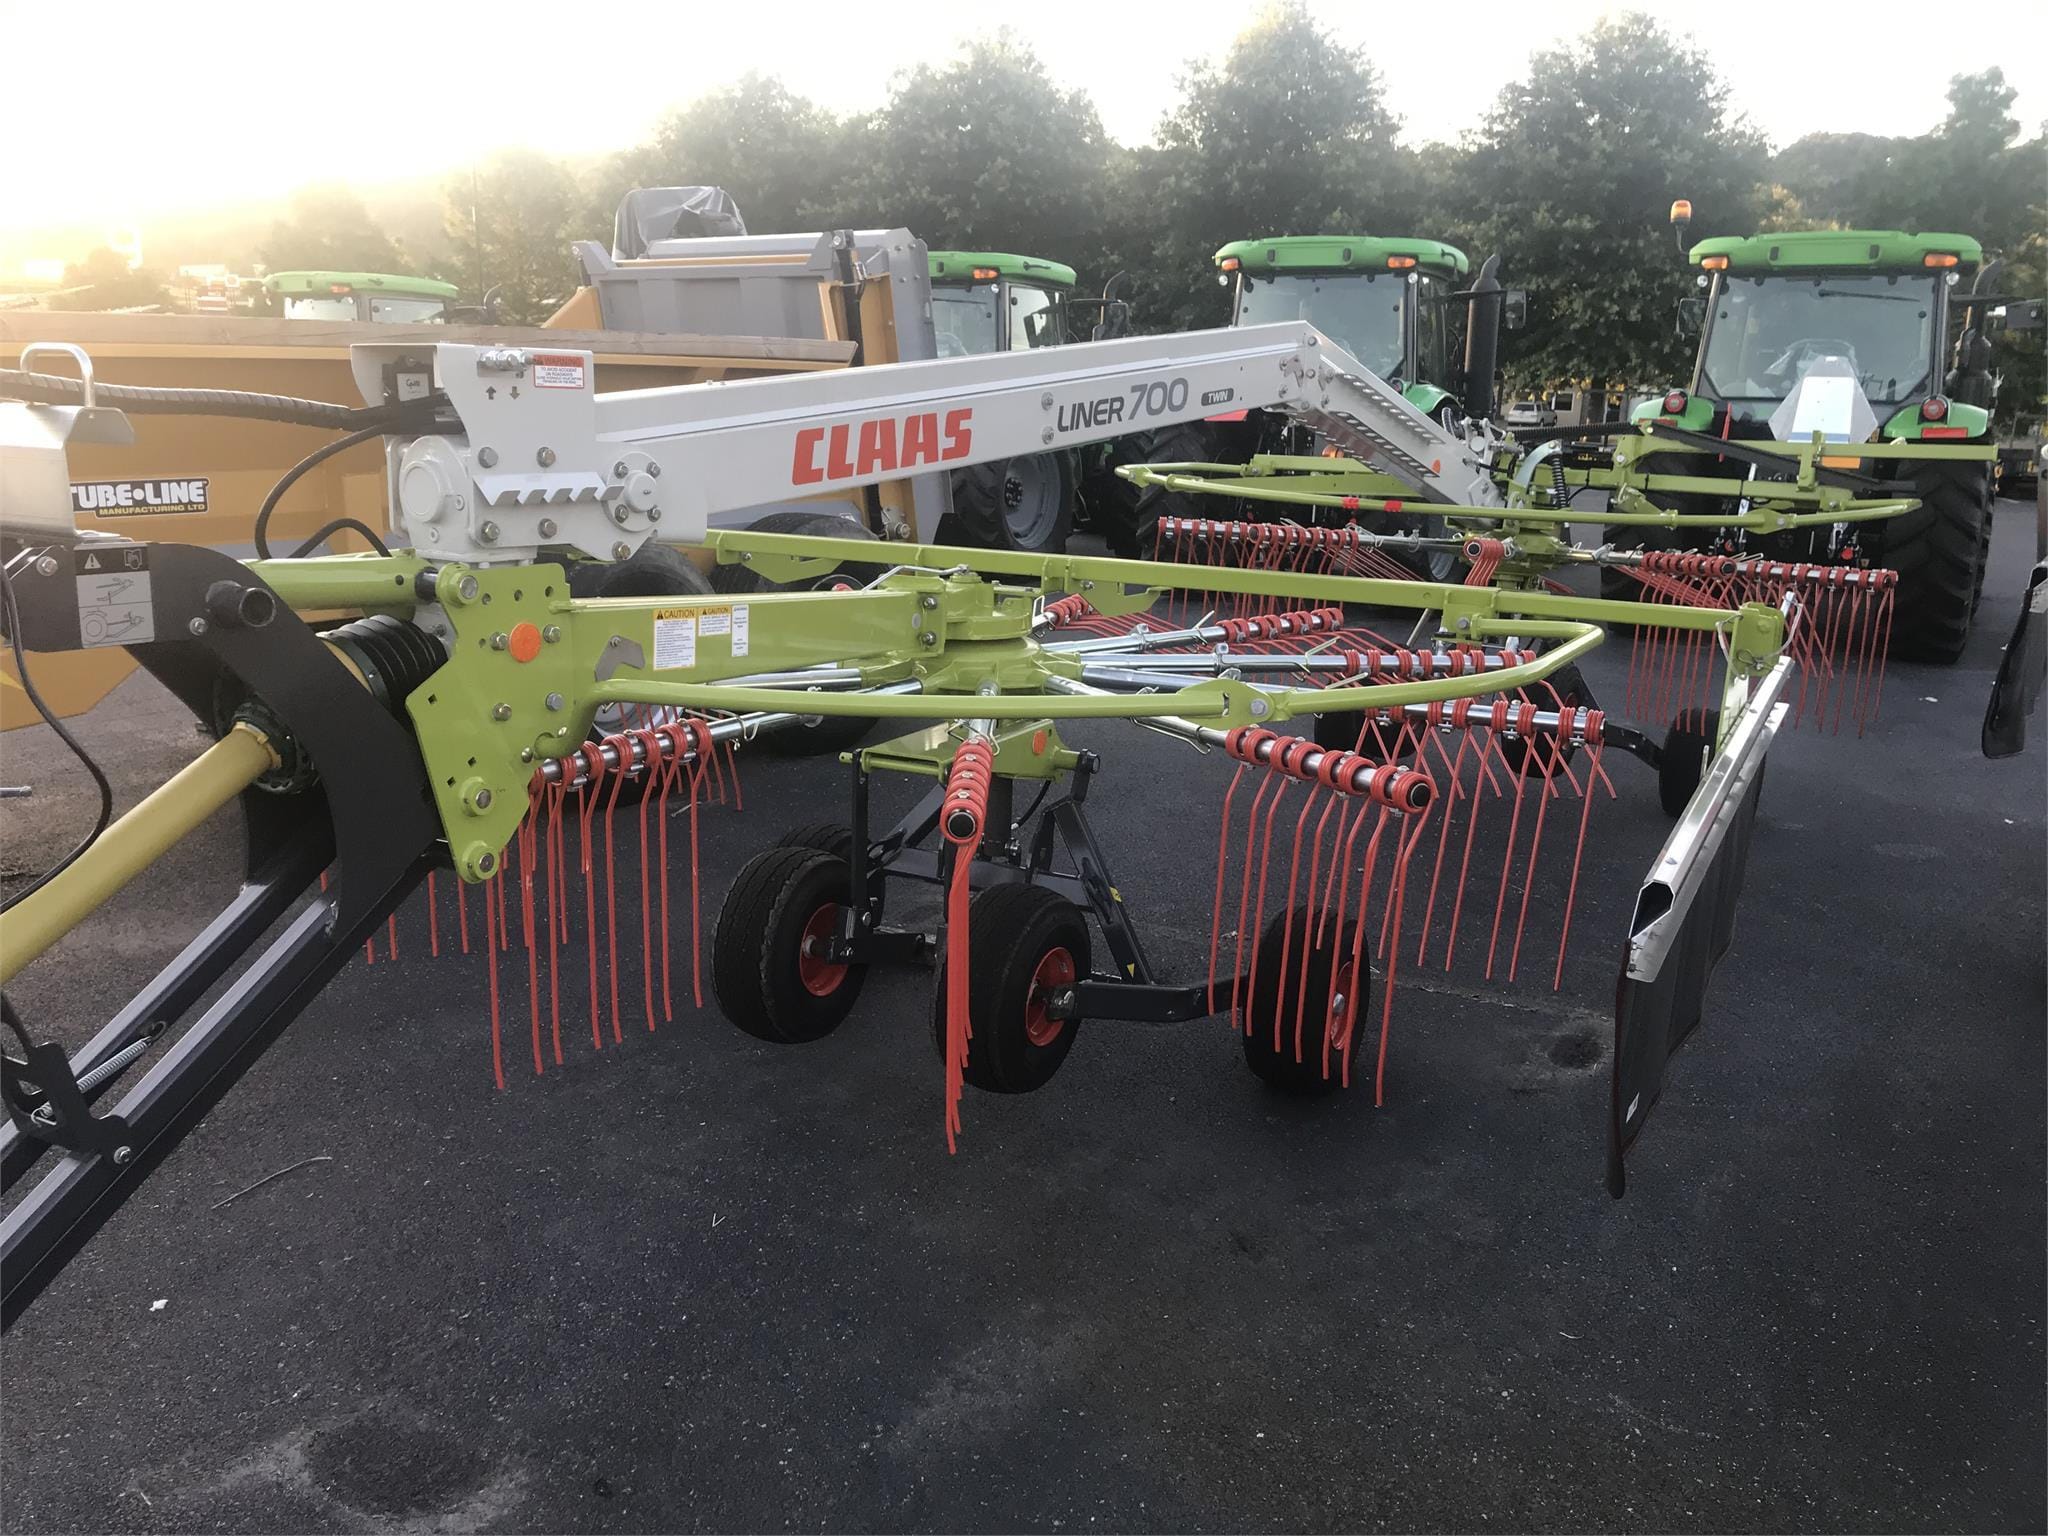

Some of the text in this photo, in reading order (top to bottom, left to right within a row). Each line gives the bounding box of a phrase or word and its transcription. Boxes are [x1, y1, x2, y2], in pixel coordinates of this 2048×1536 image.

[1207, 390, 1229, 403] TWIN
[1057, 377, 1189, 432] LINER 700
[792, 407, 972, 486] CLAAS
[99, 503, 206, 516] MANUFACTURING LTD
[664, 609, 695, 619] CAUTION
